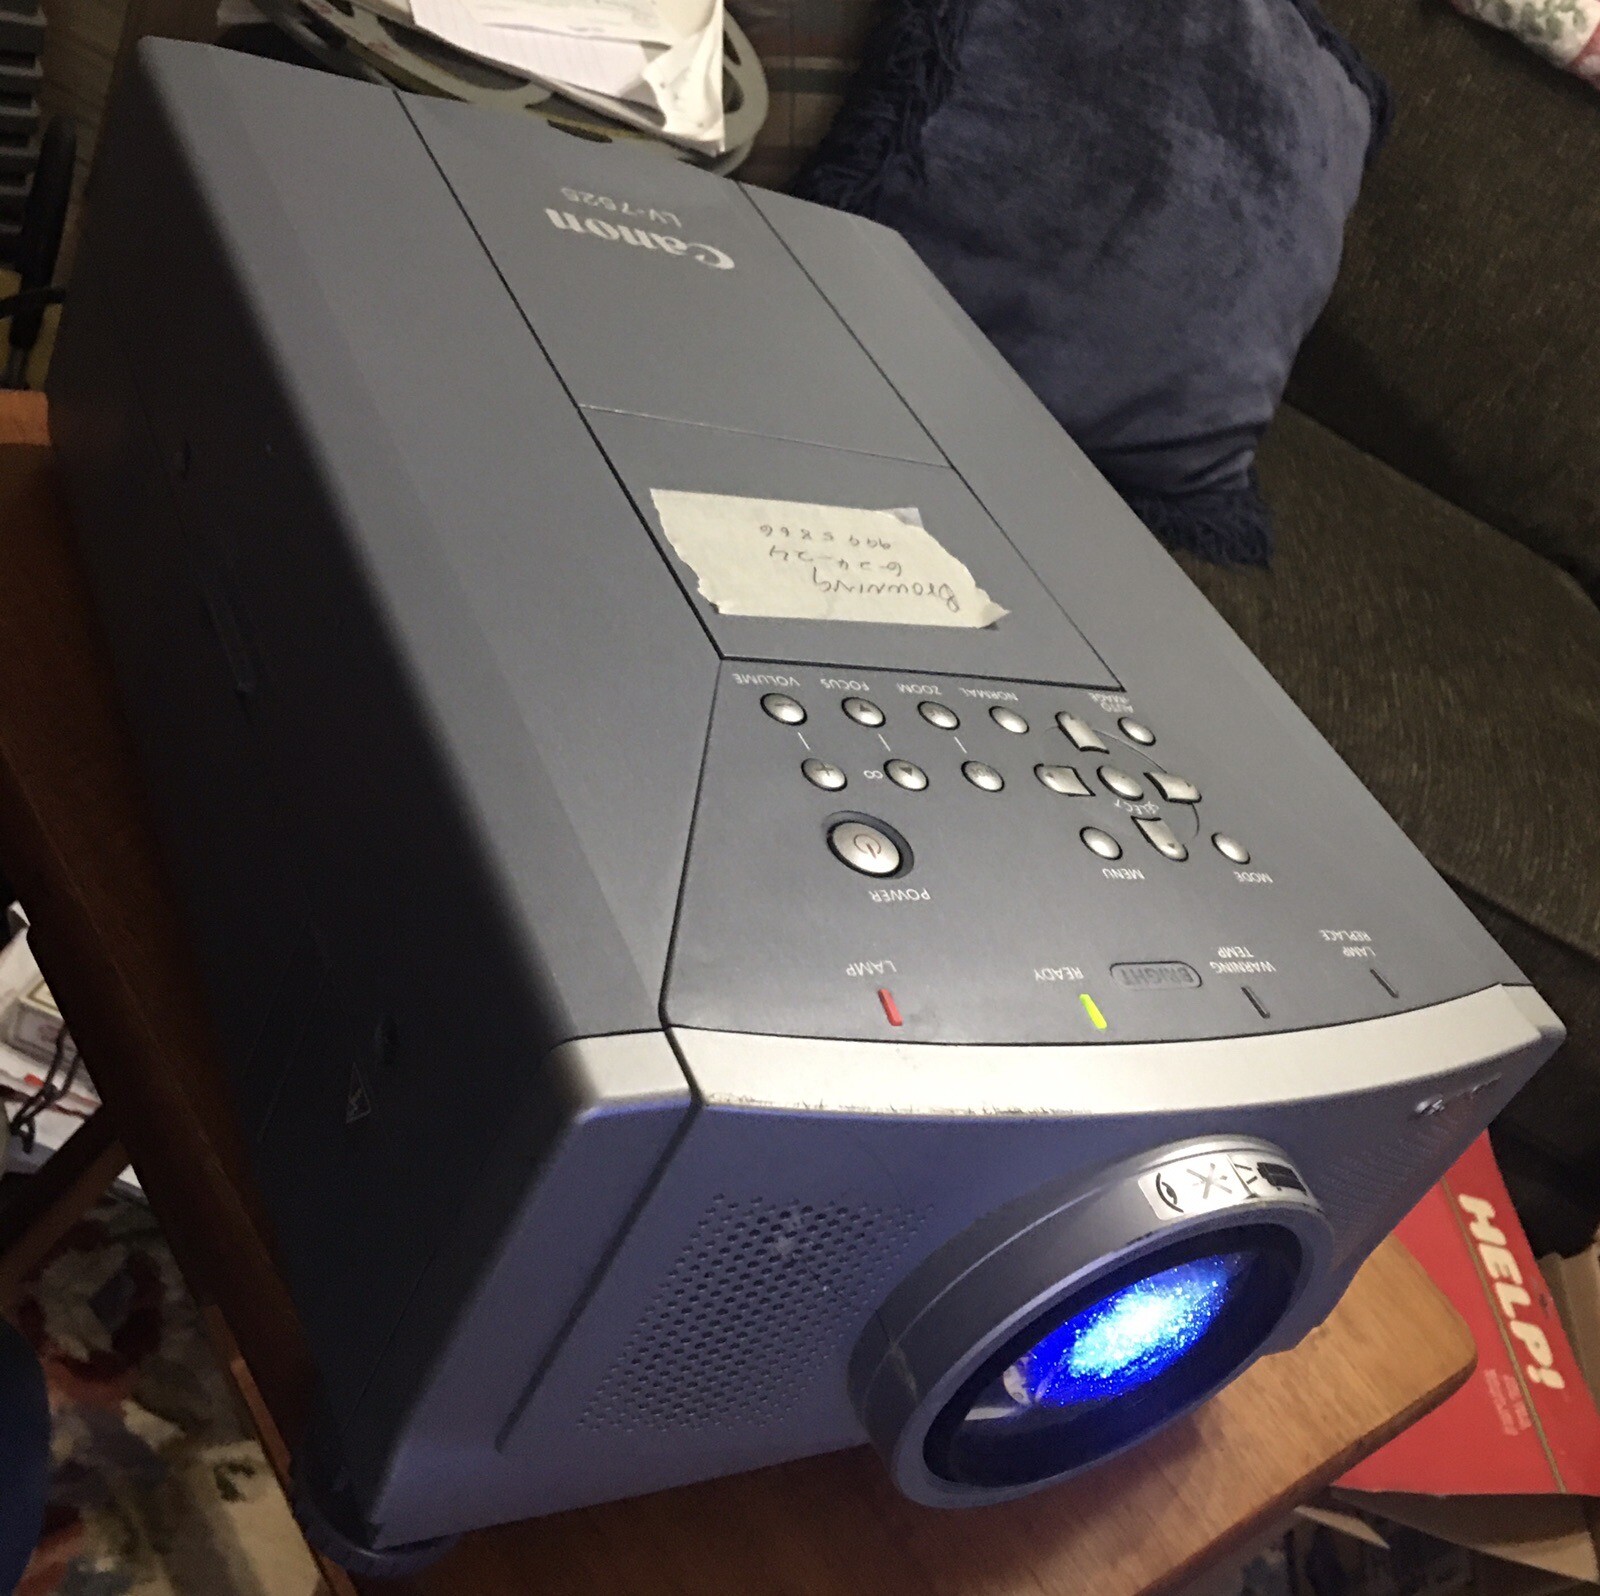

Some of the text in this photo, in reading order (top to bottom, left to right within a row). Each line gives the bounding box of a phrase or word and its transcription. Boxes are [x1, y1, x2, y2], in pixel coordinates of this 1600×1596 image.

[543, 208, 735, 270] Canon
[733, 673, 800, 686] VOLUME
[820, 678, 870, 692] FOCUS
[896, 682, 943, 696] ZOOM
[959, 687, 1019, 701] NORMAL
[1103, 868, 1145, 880] MENU
[1235, 871, 1273, 884] MODE
[868, 888, 931, 902] POWER
[1319, 929, 1372, 942] REPLACE
[1218, 946, 1254, 959] TEMP
[1343, 947, 1376, 958] LAMP
[846, 960, 897, 977] LAMP
[1034, 967, 1084, 981] READY
[1210, 961, 1276, 974] WARNING
[1121, 968, 1195, 984] BRIGHT
[1458, 1194, 1565, 1389] HELP!
